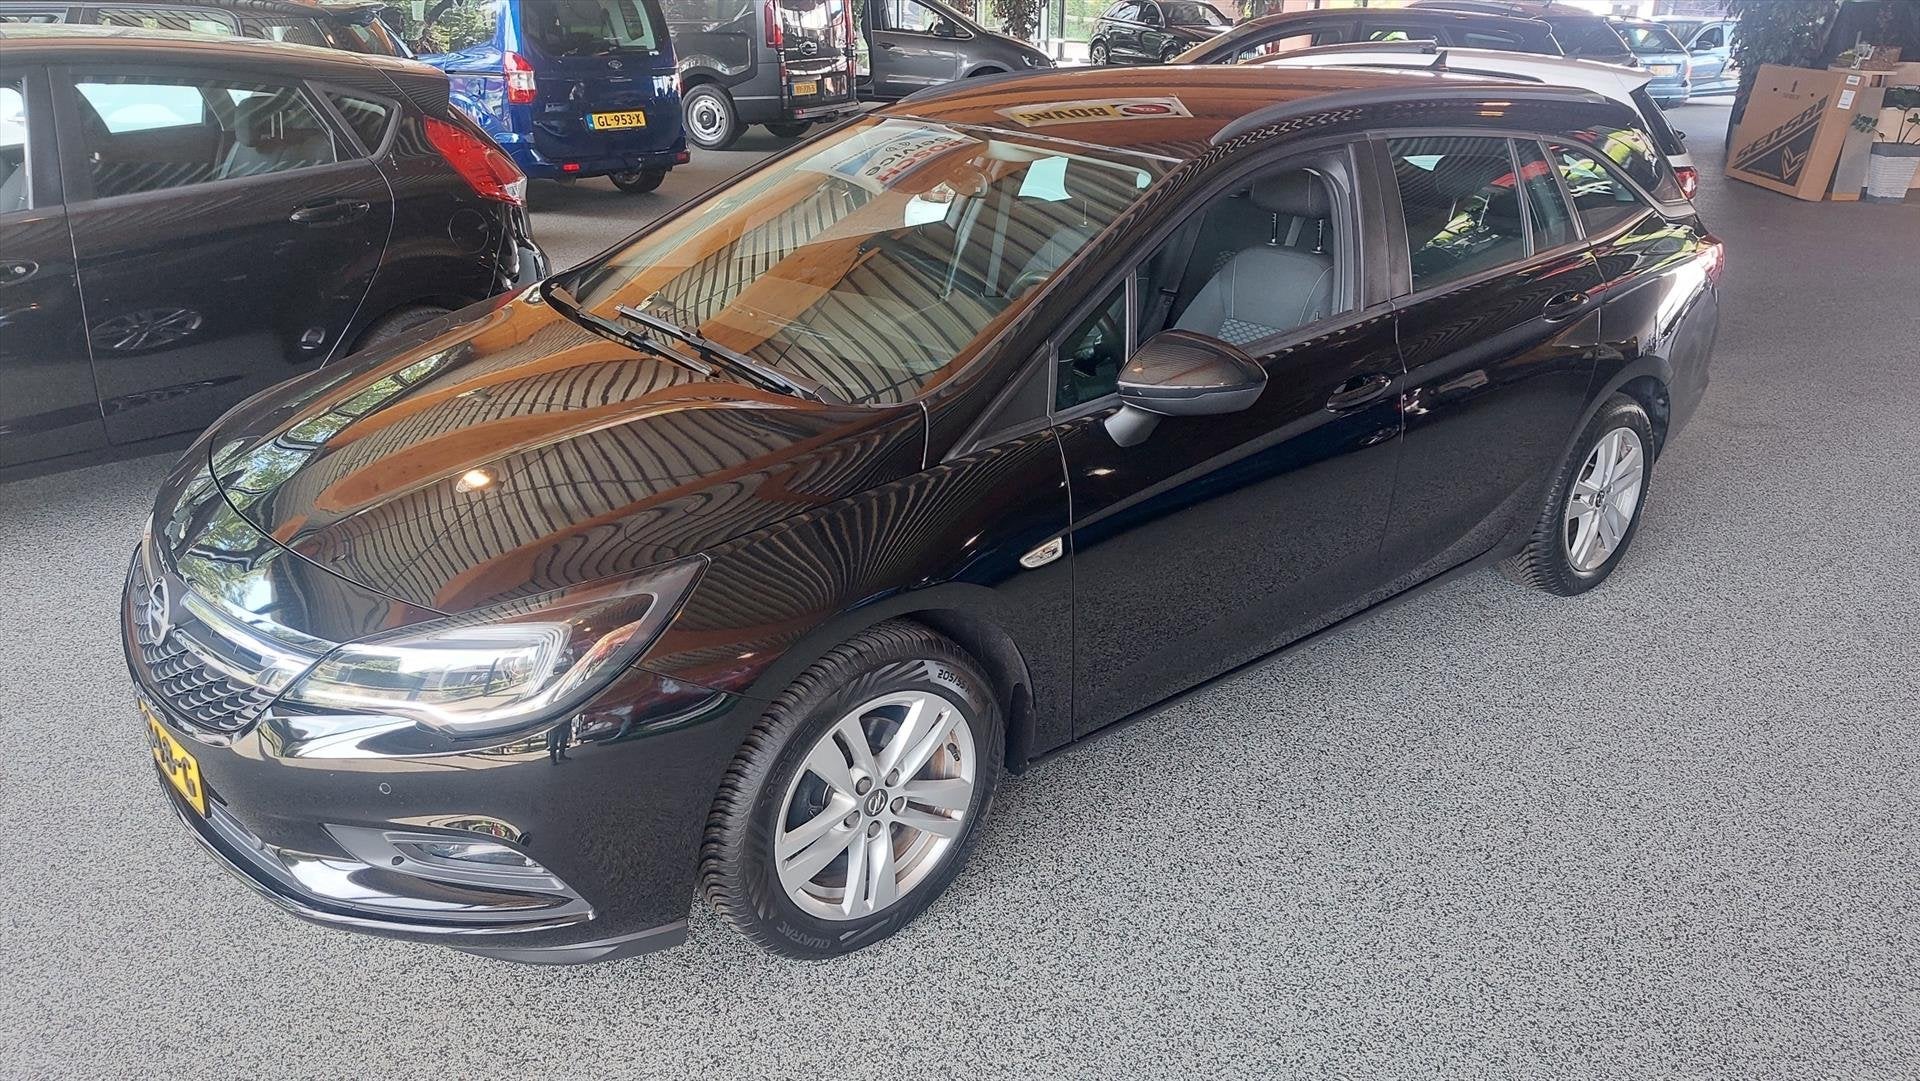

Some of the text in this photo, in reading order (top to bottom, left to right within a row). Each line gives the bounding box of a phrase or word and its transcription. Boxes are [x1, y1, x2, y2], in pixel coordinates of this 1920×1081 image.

[1019, 106, 1111, 121] BOVAG
[865, 136, 951, 177] Service
[876, 140, 963, 182] BOSCH
